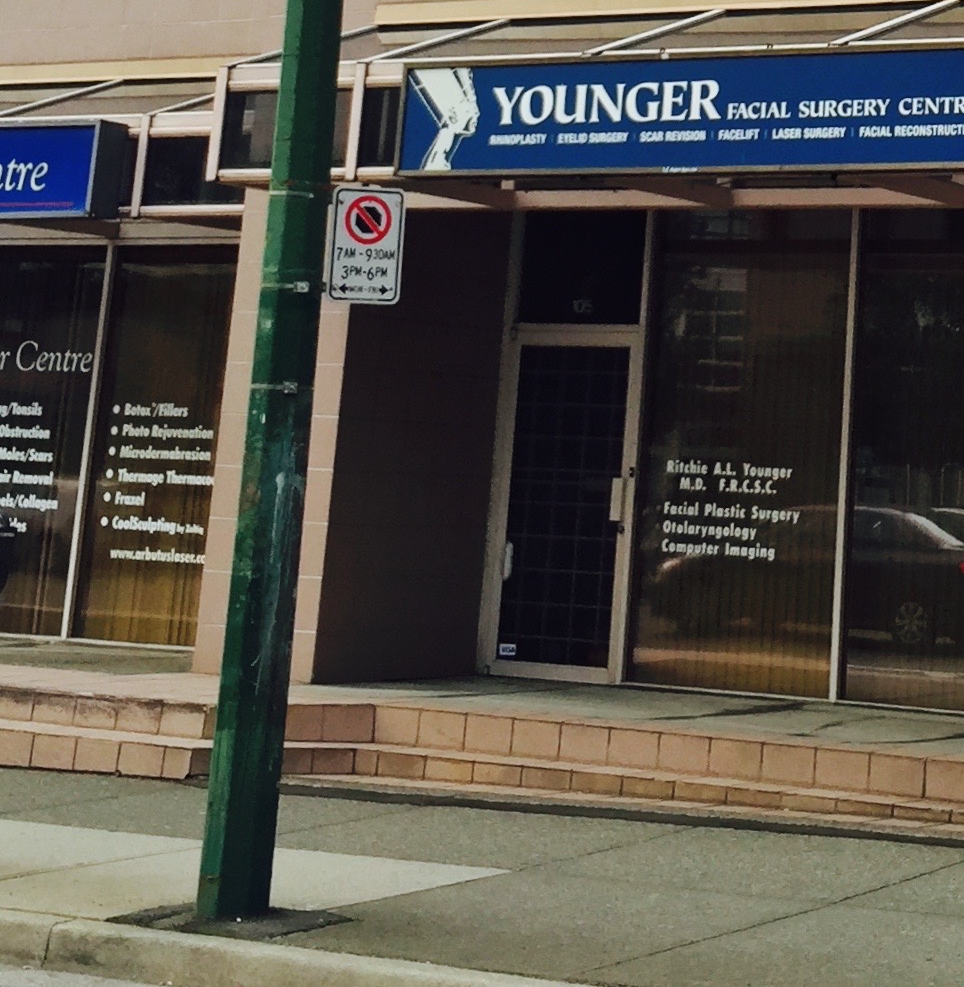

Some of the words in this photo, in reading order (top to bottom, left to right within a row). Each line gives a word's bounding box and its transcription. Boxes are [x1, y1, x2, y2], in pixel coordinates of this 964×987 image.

[493, 79, 721, 126] YOUNGER
[727, 102, 791, 120] FACIAL
[798, 99, 890, 119] SURGERY
[488, 133, 547, 146] RHINOPLASTY
[557, 133, 588, 145] EYELID
[588, 131, 629, 144] SURGERY
[640, 132, 664, 143] SCAR
[664, 130, 707, 143] REVISION
[718, 128, 760, 141] FACELIFT
[772, 128, 802, 140] LASER
[803, 127, 846, 139] SURGERY
[859, 126, 892, 138] FACIAL
[0, 158, 49, 193] tre
[16, 339, 94, 373] Centre
[122, 423, 150, 438] Photo
[151, 424, 214, 441] Rejuvenation
[119, 444, 212, 462] Microdermabrasion
[12, 469, 54, 486] Removal
[118, 467, 165, 487] Thermage
[666, 459, 709, 476] Ritchie
[713, 462, 737, 477] A.L.
[743, 463, 794, 482] Younger
[679, 477, 707, 491] M.D.
[718, 478, 778, 494] F.R.C.S.C.
[114, 491, 146, 507] Fraxel
[663, 500, 700, 517] Facial
[704, 502, 747, 519] Plastic
[751, 505, 801, 525] Surgery
[112, 515, 177, 535] CoolSculpting
[662, 520, 758, 541] Otolaryngology
[661, 538, 720, 556] Computer
[725, 542, 776, 562] Imaging
